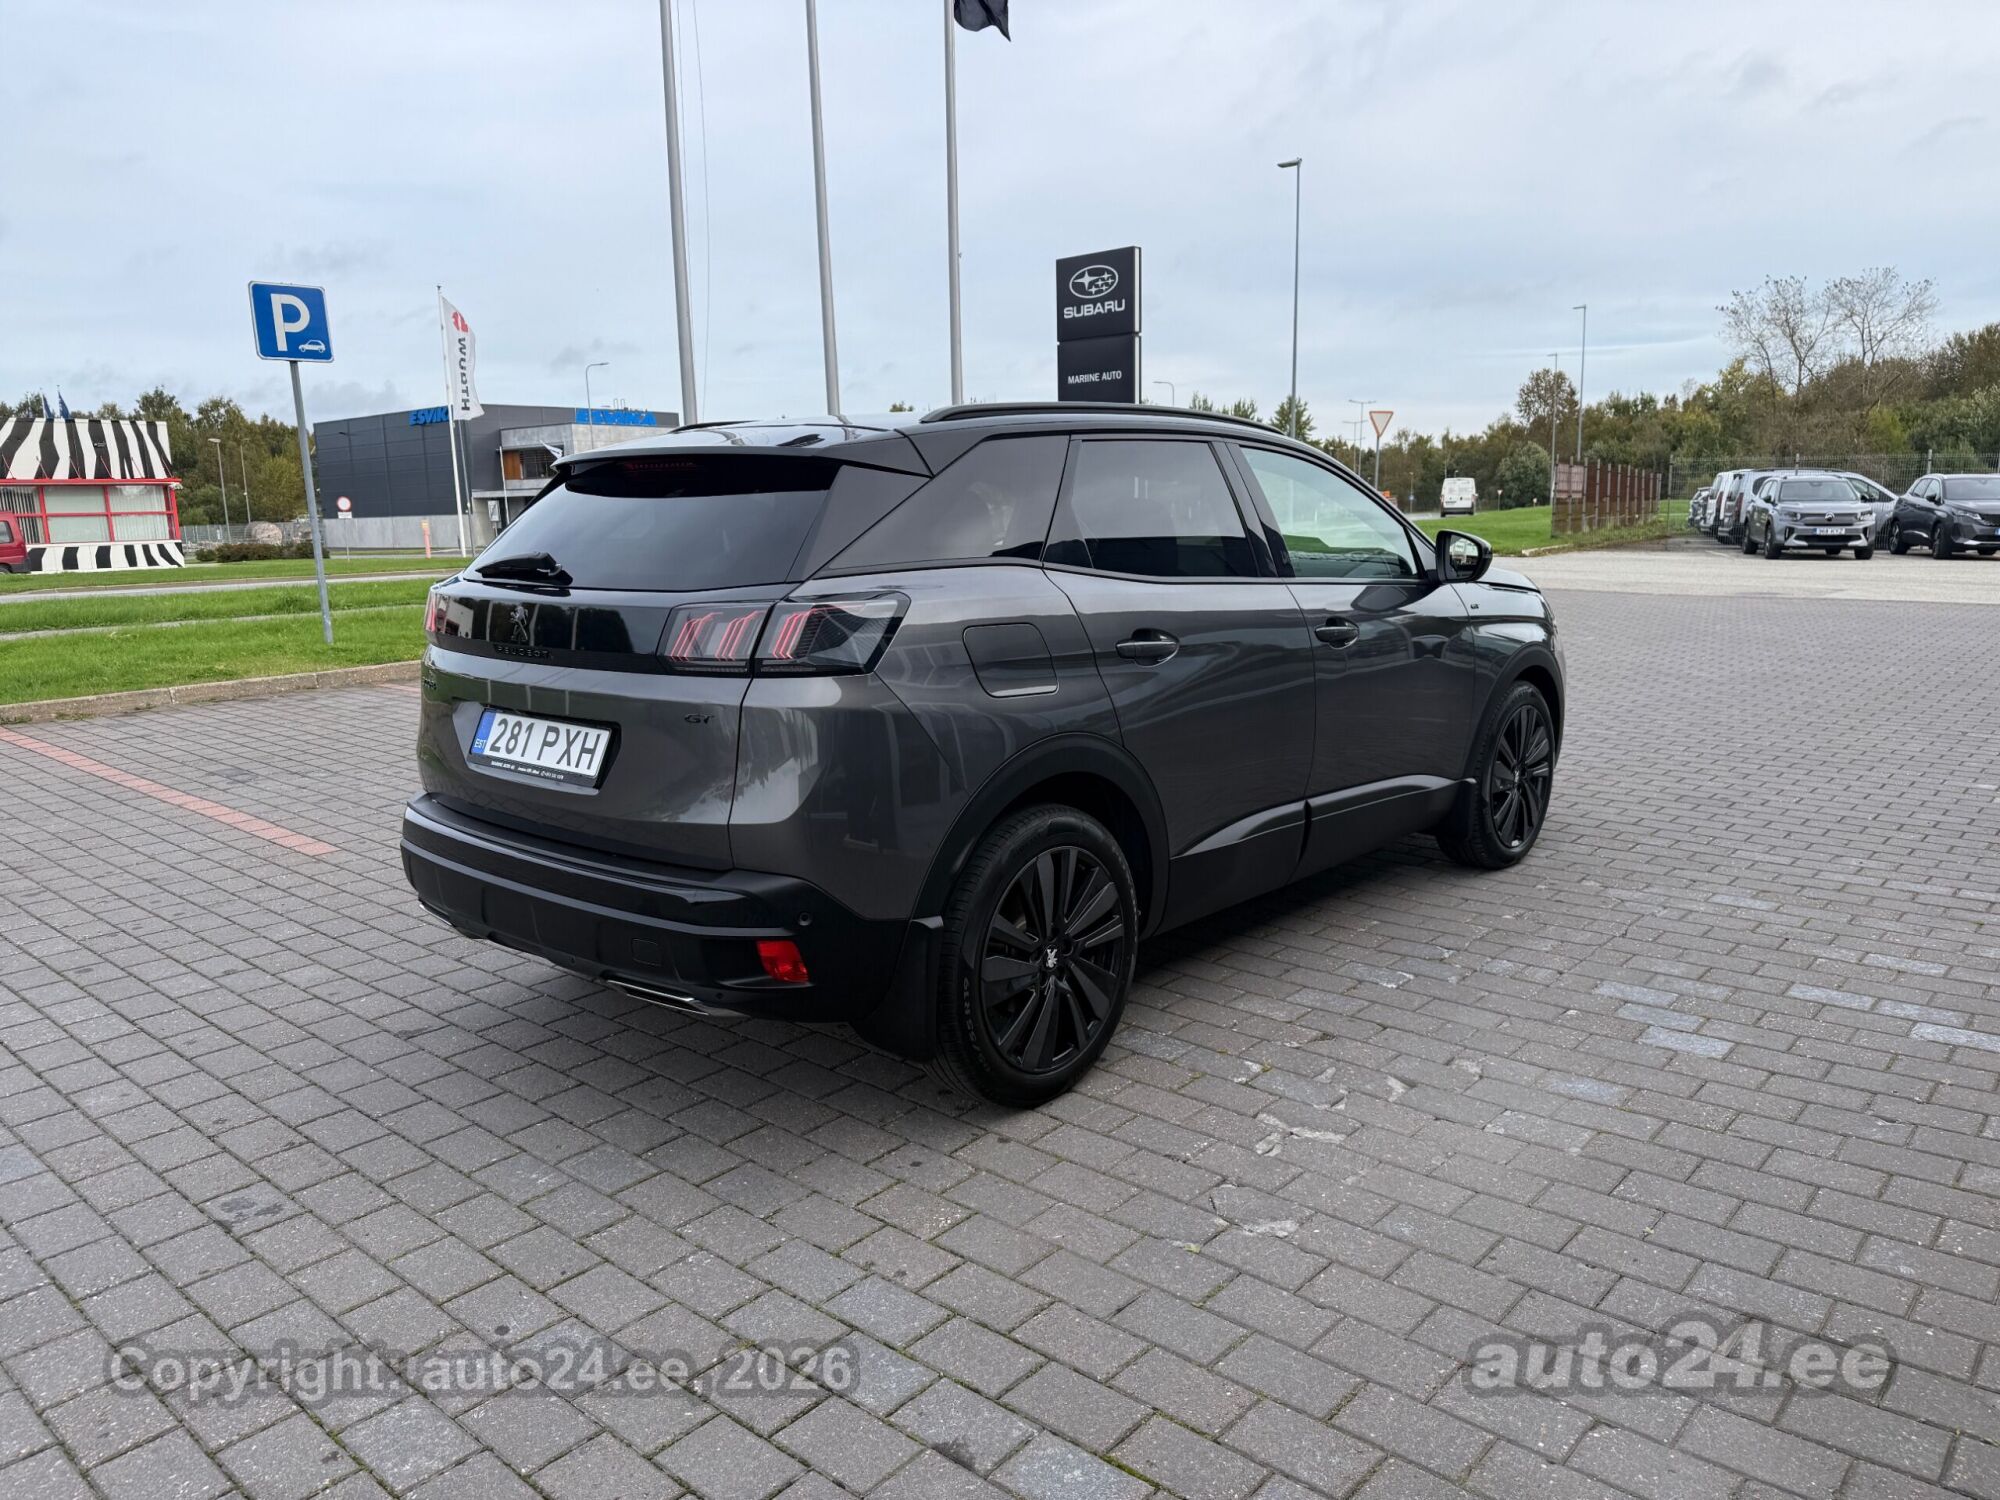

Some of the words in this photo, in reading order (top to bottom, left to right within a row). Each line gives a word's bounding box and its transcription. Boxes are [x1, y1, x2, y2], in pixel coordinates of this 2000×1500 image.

[1063, 299, 1126, 319] SUBARU
[270, 293, 311, 352] P
[1101, 370, 1122, 381] AUTO
[408, 405, 450, 425] ESVIK
[497, 645, 549, 659] PEUGEOT
[474, 738, 487, 749] EST
[489, 717, 535, 758] 281
[536, 725, 601, 771] PXH
